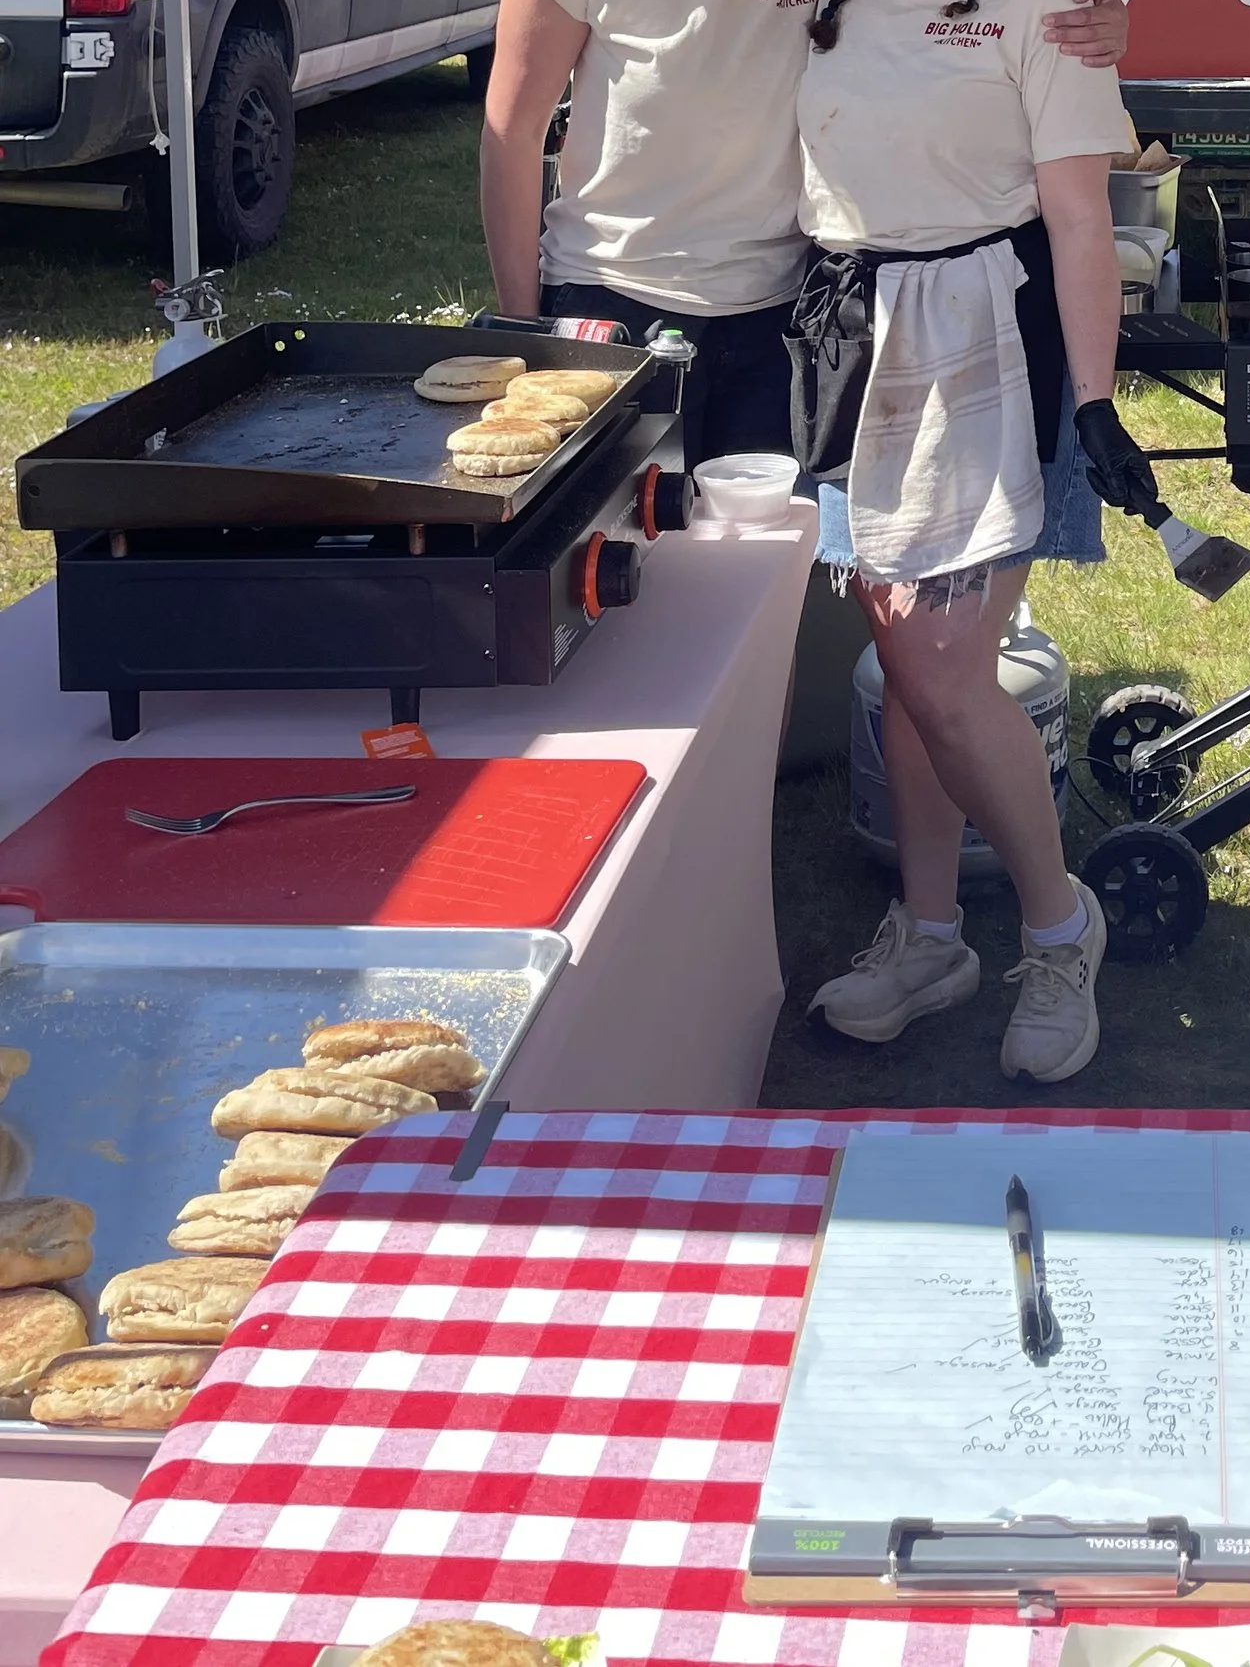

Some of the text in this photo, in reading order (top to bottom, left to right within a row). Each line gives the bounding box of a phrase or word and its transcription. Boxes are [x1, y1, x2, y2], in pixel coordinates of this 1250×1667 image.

[925, 22, 1005, 39] BIG HOLLOW
[938, 37, 977, 48] KITCHEN
[794, 1540, 840, 1551] 100%
[1085, 1538, 1178, 1551] OFESSIONAL
